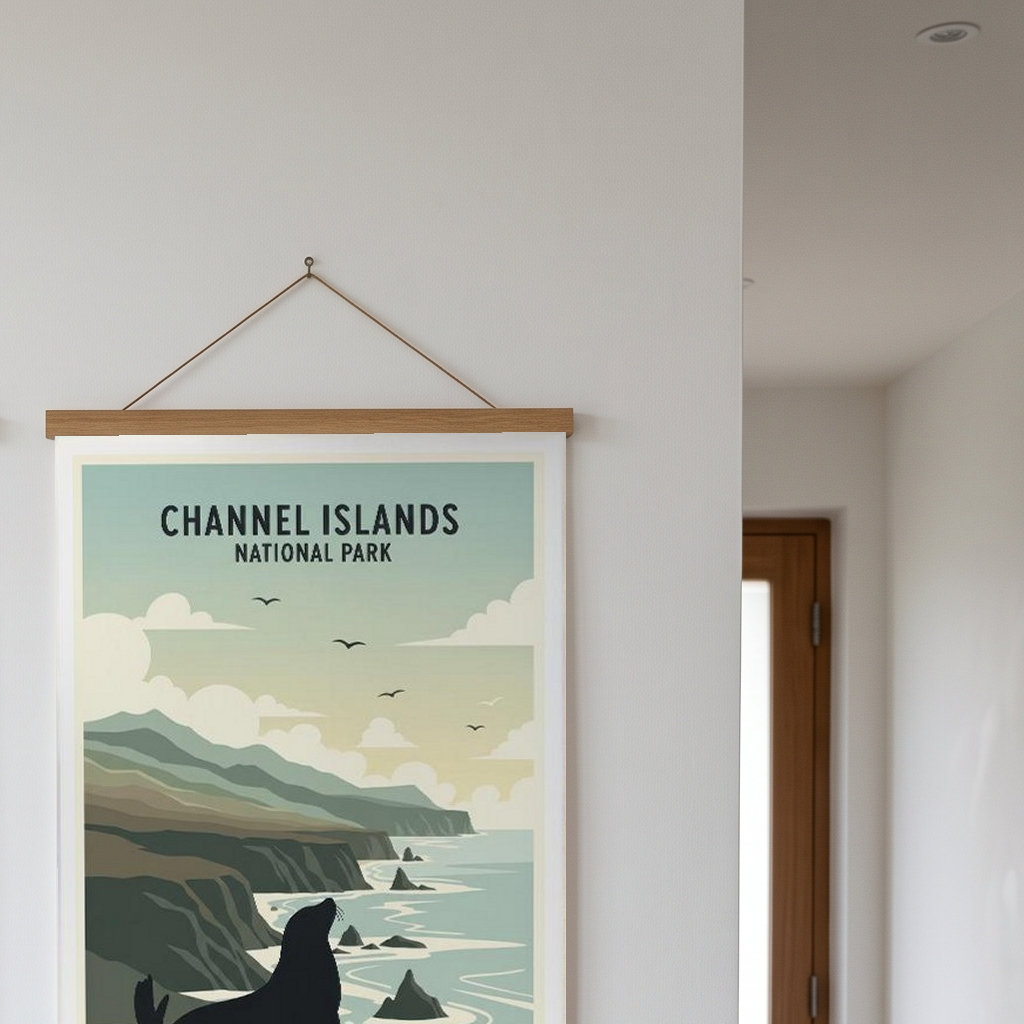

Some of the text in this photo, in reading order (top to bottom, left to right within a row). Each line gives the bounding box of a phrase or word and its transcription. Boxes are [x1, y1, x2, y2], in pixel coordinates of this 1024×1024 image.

[160, 502, 460, 537] CHANNEL ISLANDS
[234, 542, 392, 563] NATIONAL PARK
